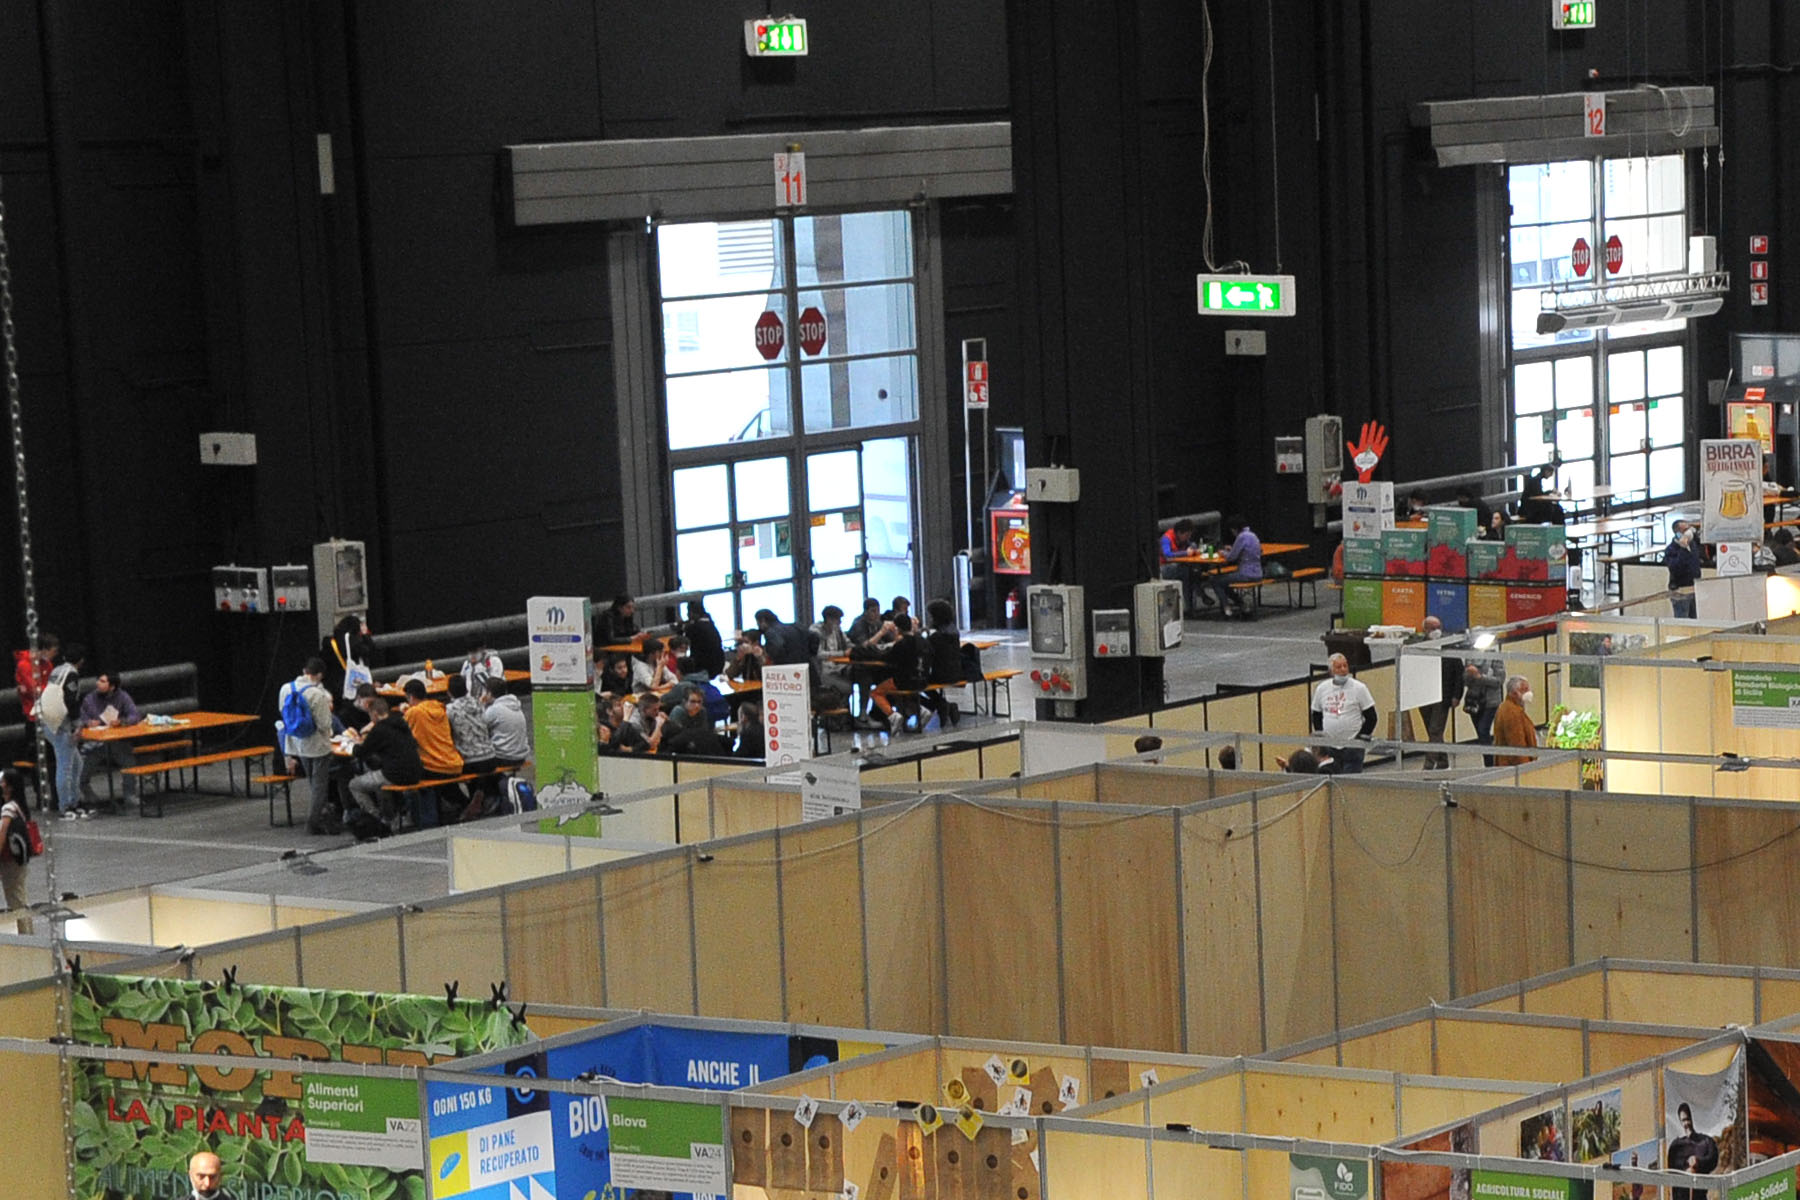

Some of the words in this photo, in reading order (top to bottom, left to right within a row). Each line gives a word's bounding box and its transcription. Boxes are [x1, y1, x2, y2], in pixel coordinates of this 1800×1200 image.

[1588, 108, 1604, 136] 12
[782, 171, 803, 204] 11
[1572, 249, 1589, 265] STOP
[1606, 247, 1622, 260] STOP
[756, 325, 783, 346] STOP
[800, 322, 826, 342] STOP
[1706, 444, 1756, 461] BIRRA
[765, 672, 787, 682] AREA
[765, 682, 802, 692] RISTORO
[687, 1059, 739, 1086] ANCHE
[306, 1082, 359, 1098] Alimenti
[307, 1097, 364, 1114] Superiori
[433, 1095, 458, 1117] OGNI
[459, 1090, 477, 1111] 150
[477, 1087, 493, 1107] KG
[107, 1097, 151, 1126] LA
[175, 1104, 306, 1144] PIANTA
[612, 1114, 648, 1129] Biova
[479, 1136, 489, 1153] DI
[491, 1129, 516, 1150] PANE
[479, 1144, 540, 1175] RECUPERATO
[1334, 1181, 1354, 1192] FIDO
[1475, 1182, 1531, 1199] AGRICOLTURA
[1759, 1176, 1788, 1200] Solidali
